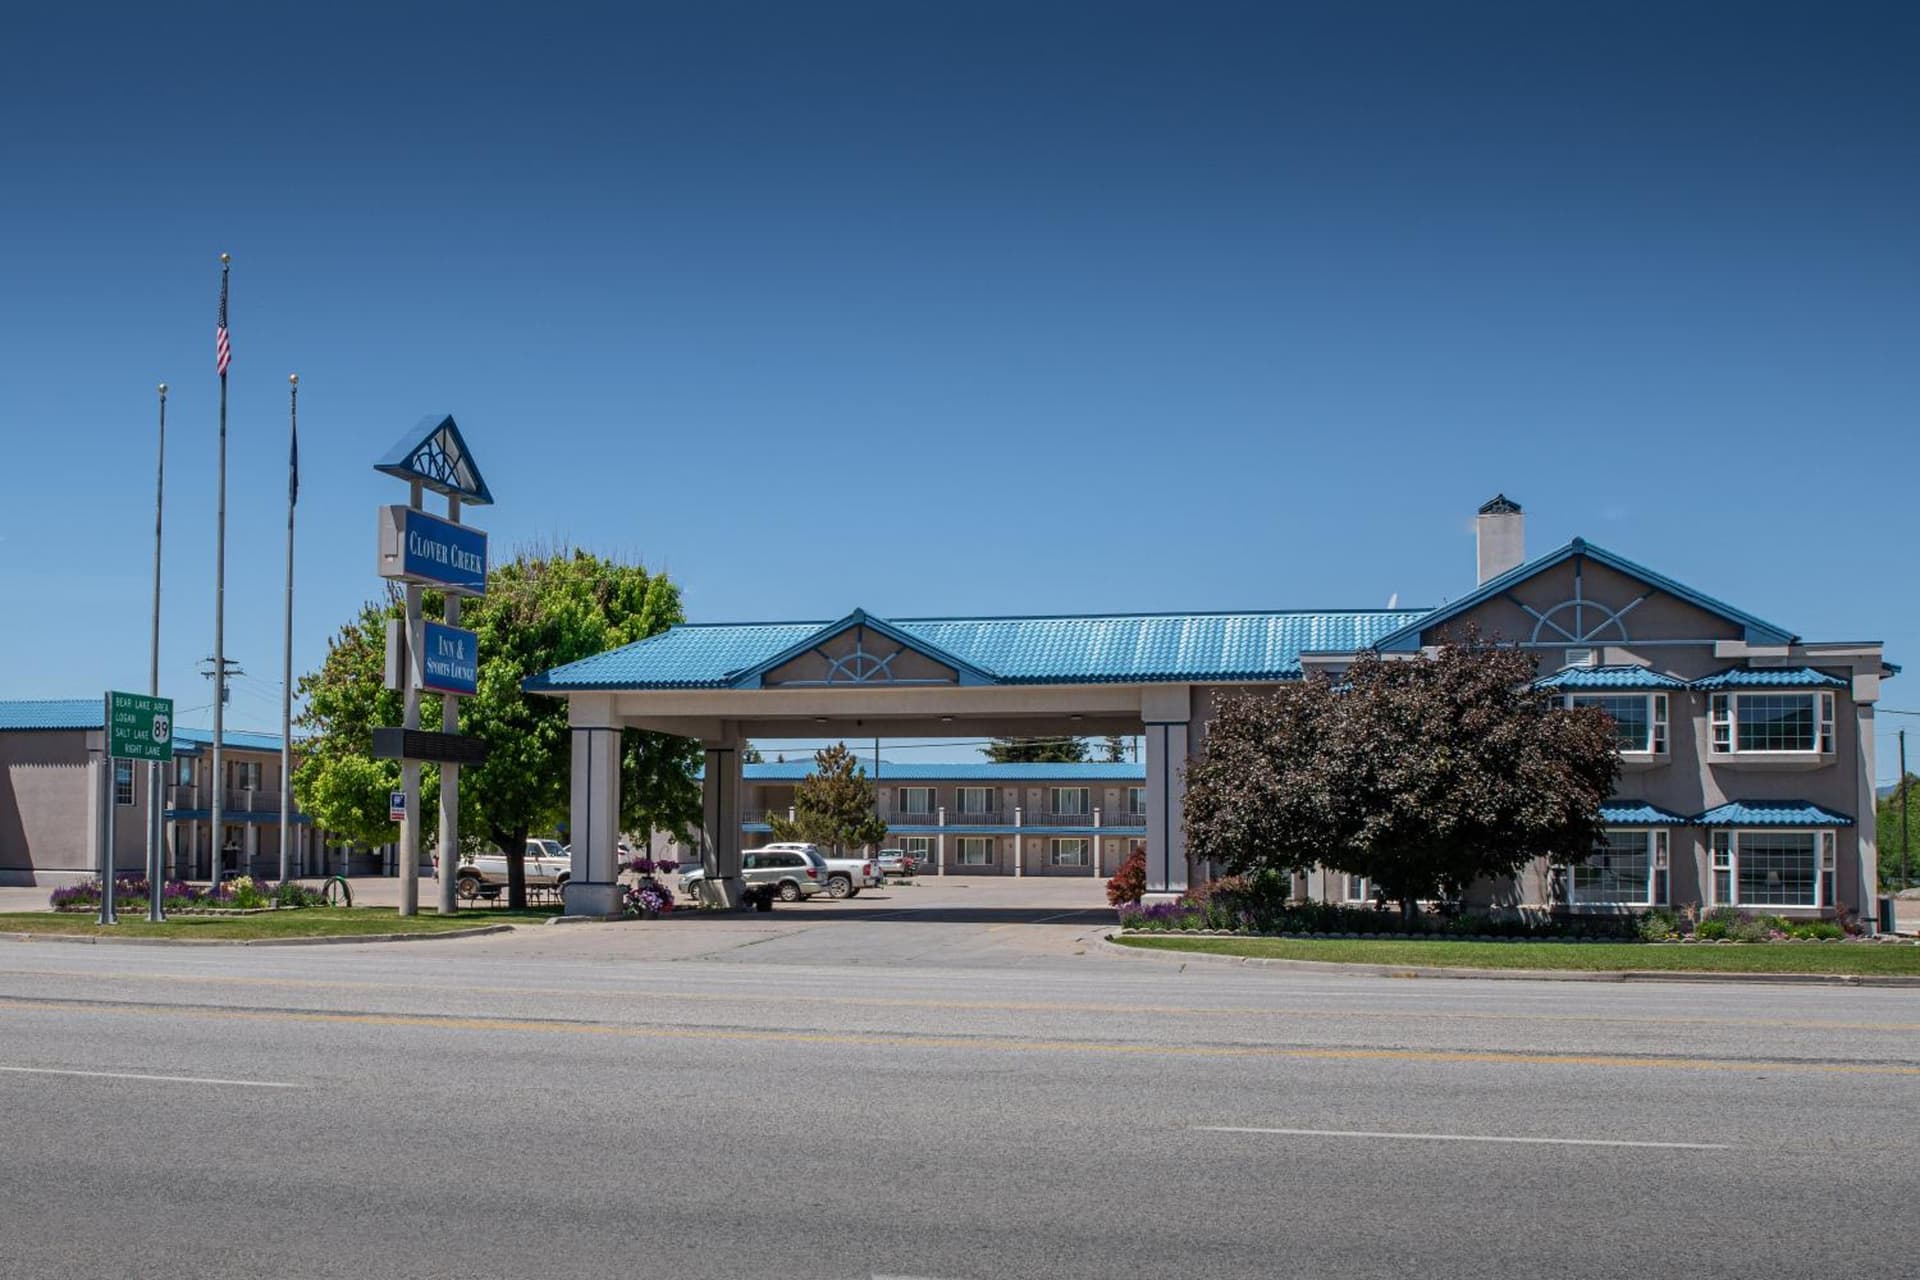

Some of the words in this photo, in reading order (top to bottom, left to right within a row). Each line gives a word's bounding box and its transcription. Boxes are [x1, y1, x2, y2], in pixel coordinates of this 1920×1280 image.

[409, 529, 448, 565] CLOVER
[450, 543, 482, 575] CREEK
[438, 634, 455, 659] INN
[456, 639, 465, 660] &
[115, 696, 131, 707] BEAR
[135, 699, 150, 710] LAKE
[115, 711, 136, 723] LOGAN
[115, 727, 131, 738] SALT
[134, 729, 149, 740] LAKE
[155, 720, 168, 737] 89
[125, 743, 142, 754] RIGHT
[145, 746, 160, 756] LANE
